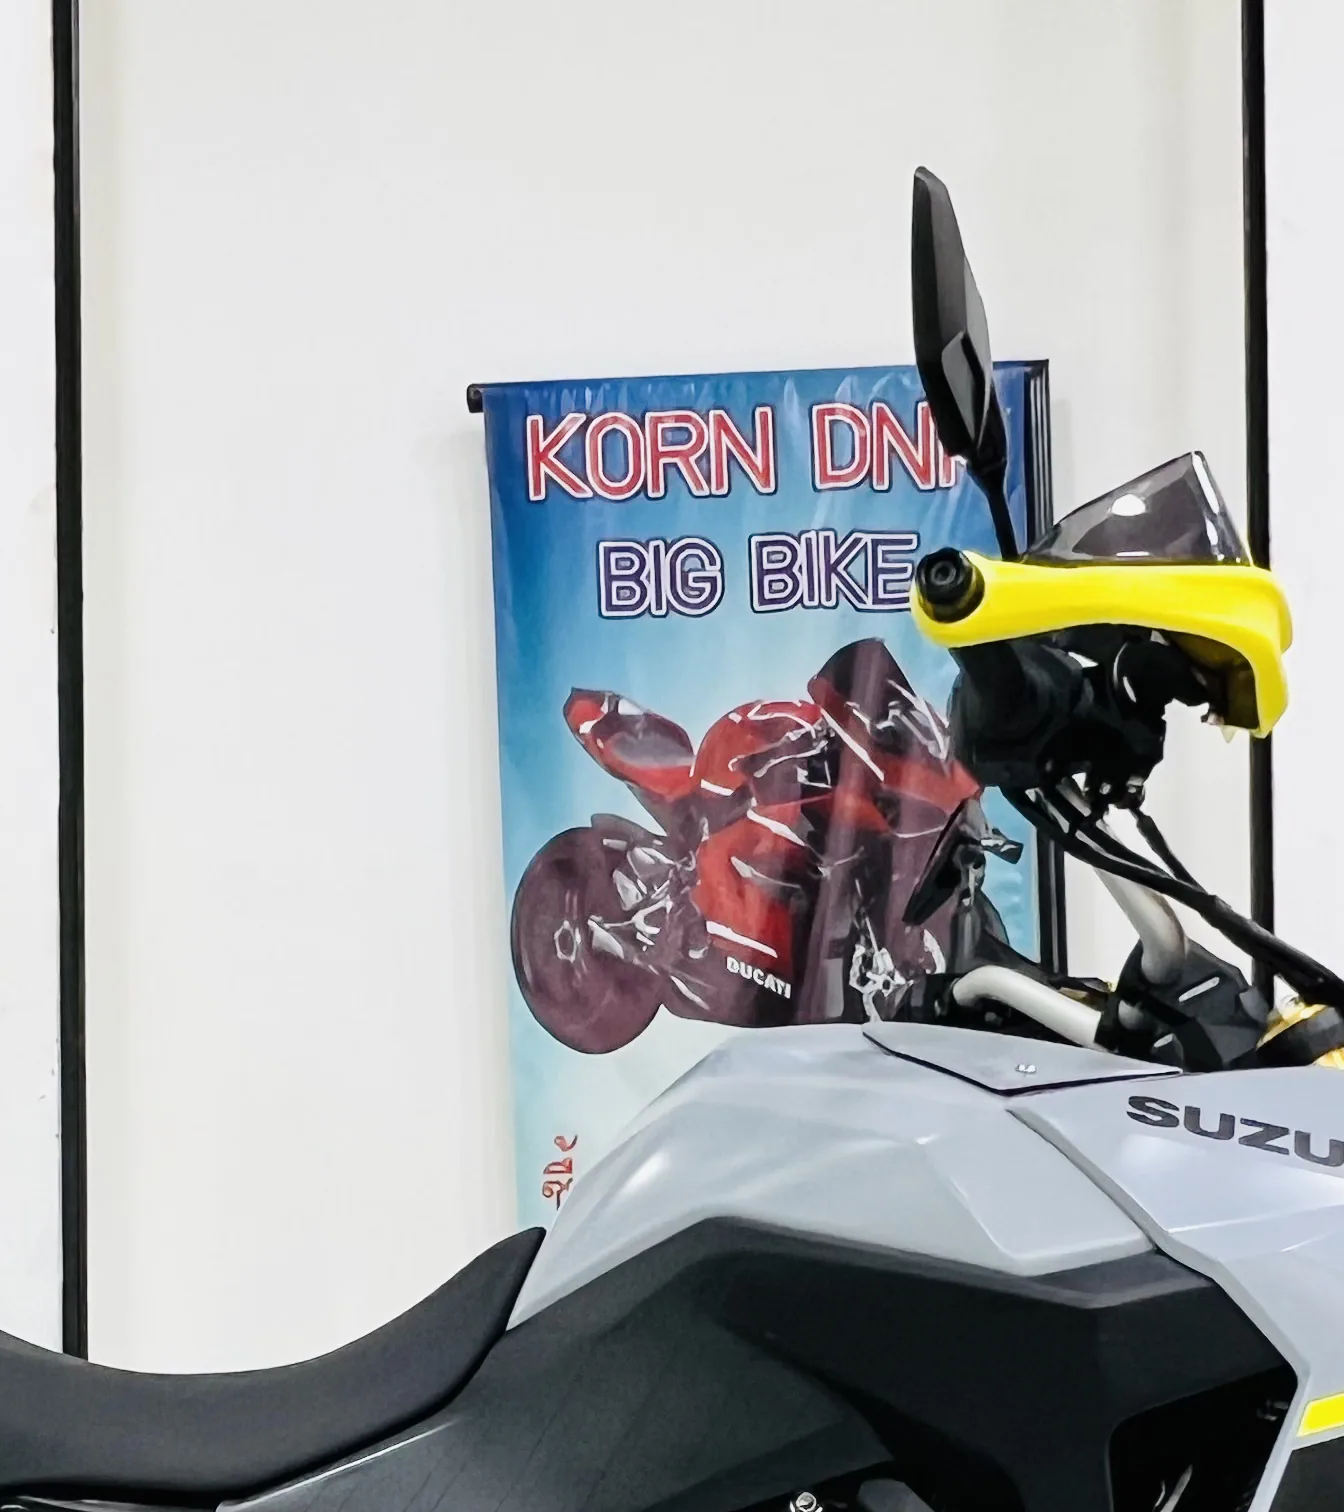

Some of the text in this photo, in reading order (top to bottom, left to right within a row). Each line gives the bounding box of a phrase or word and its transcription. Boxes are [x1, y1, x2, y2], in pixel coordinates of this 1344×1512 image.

[525, 408, 777, 502] KORN
[598, 529, 920, 618] BIG BIKE
[726, 956, 791, 999] DUCATI
